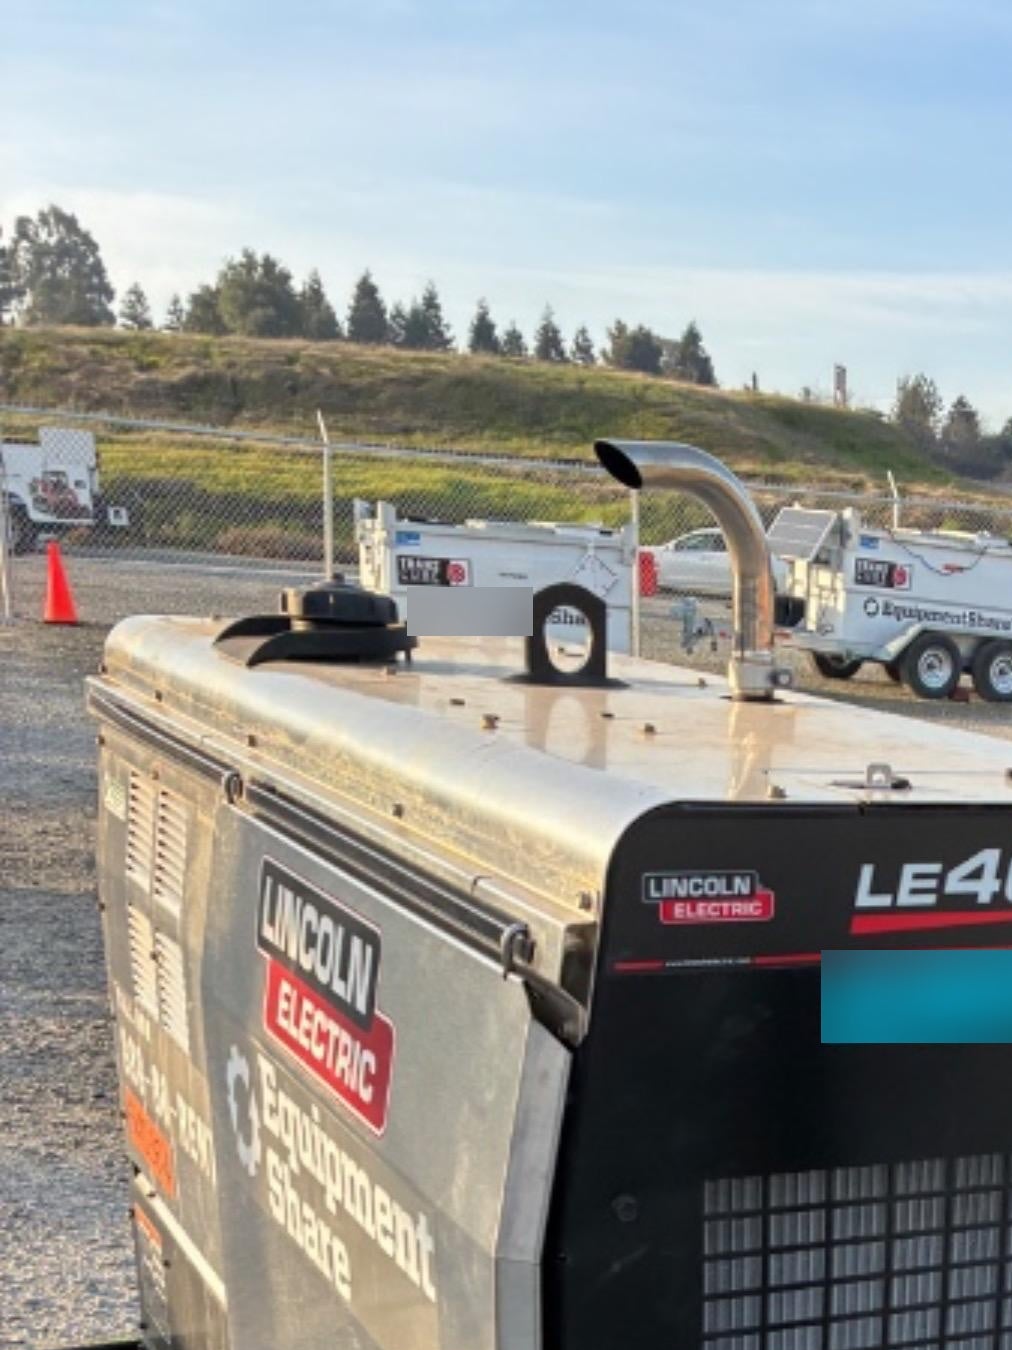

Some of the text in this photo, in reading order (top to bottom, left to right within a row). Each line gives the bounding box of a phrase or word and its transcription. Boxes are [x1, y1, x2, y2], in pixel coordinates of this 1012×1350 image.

[261, 875, 373, 1015] LINCOLN
[649, 875, 752, 898] LINCOLN
[674, 901, 763, 919] ELECTRIC
[276, 978, 378, 1104] ELECTRIC
[257, 1052, 437, 1304] Equipment
[266, 1148, 352, 1301] Share
